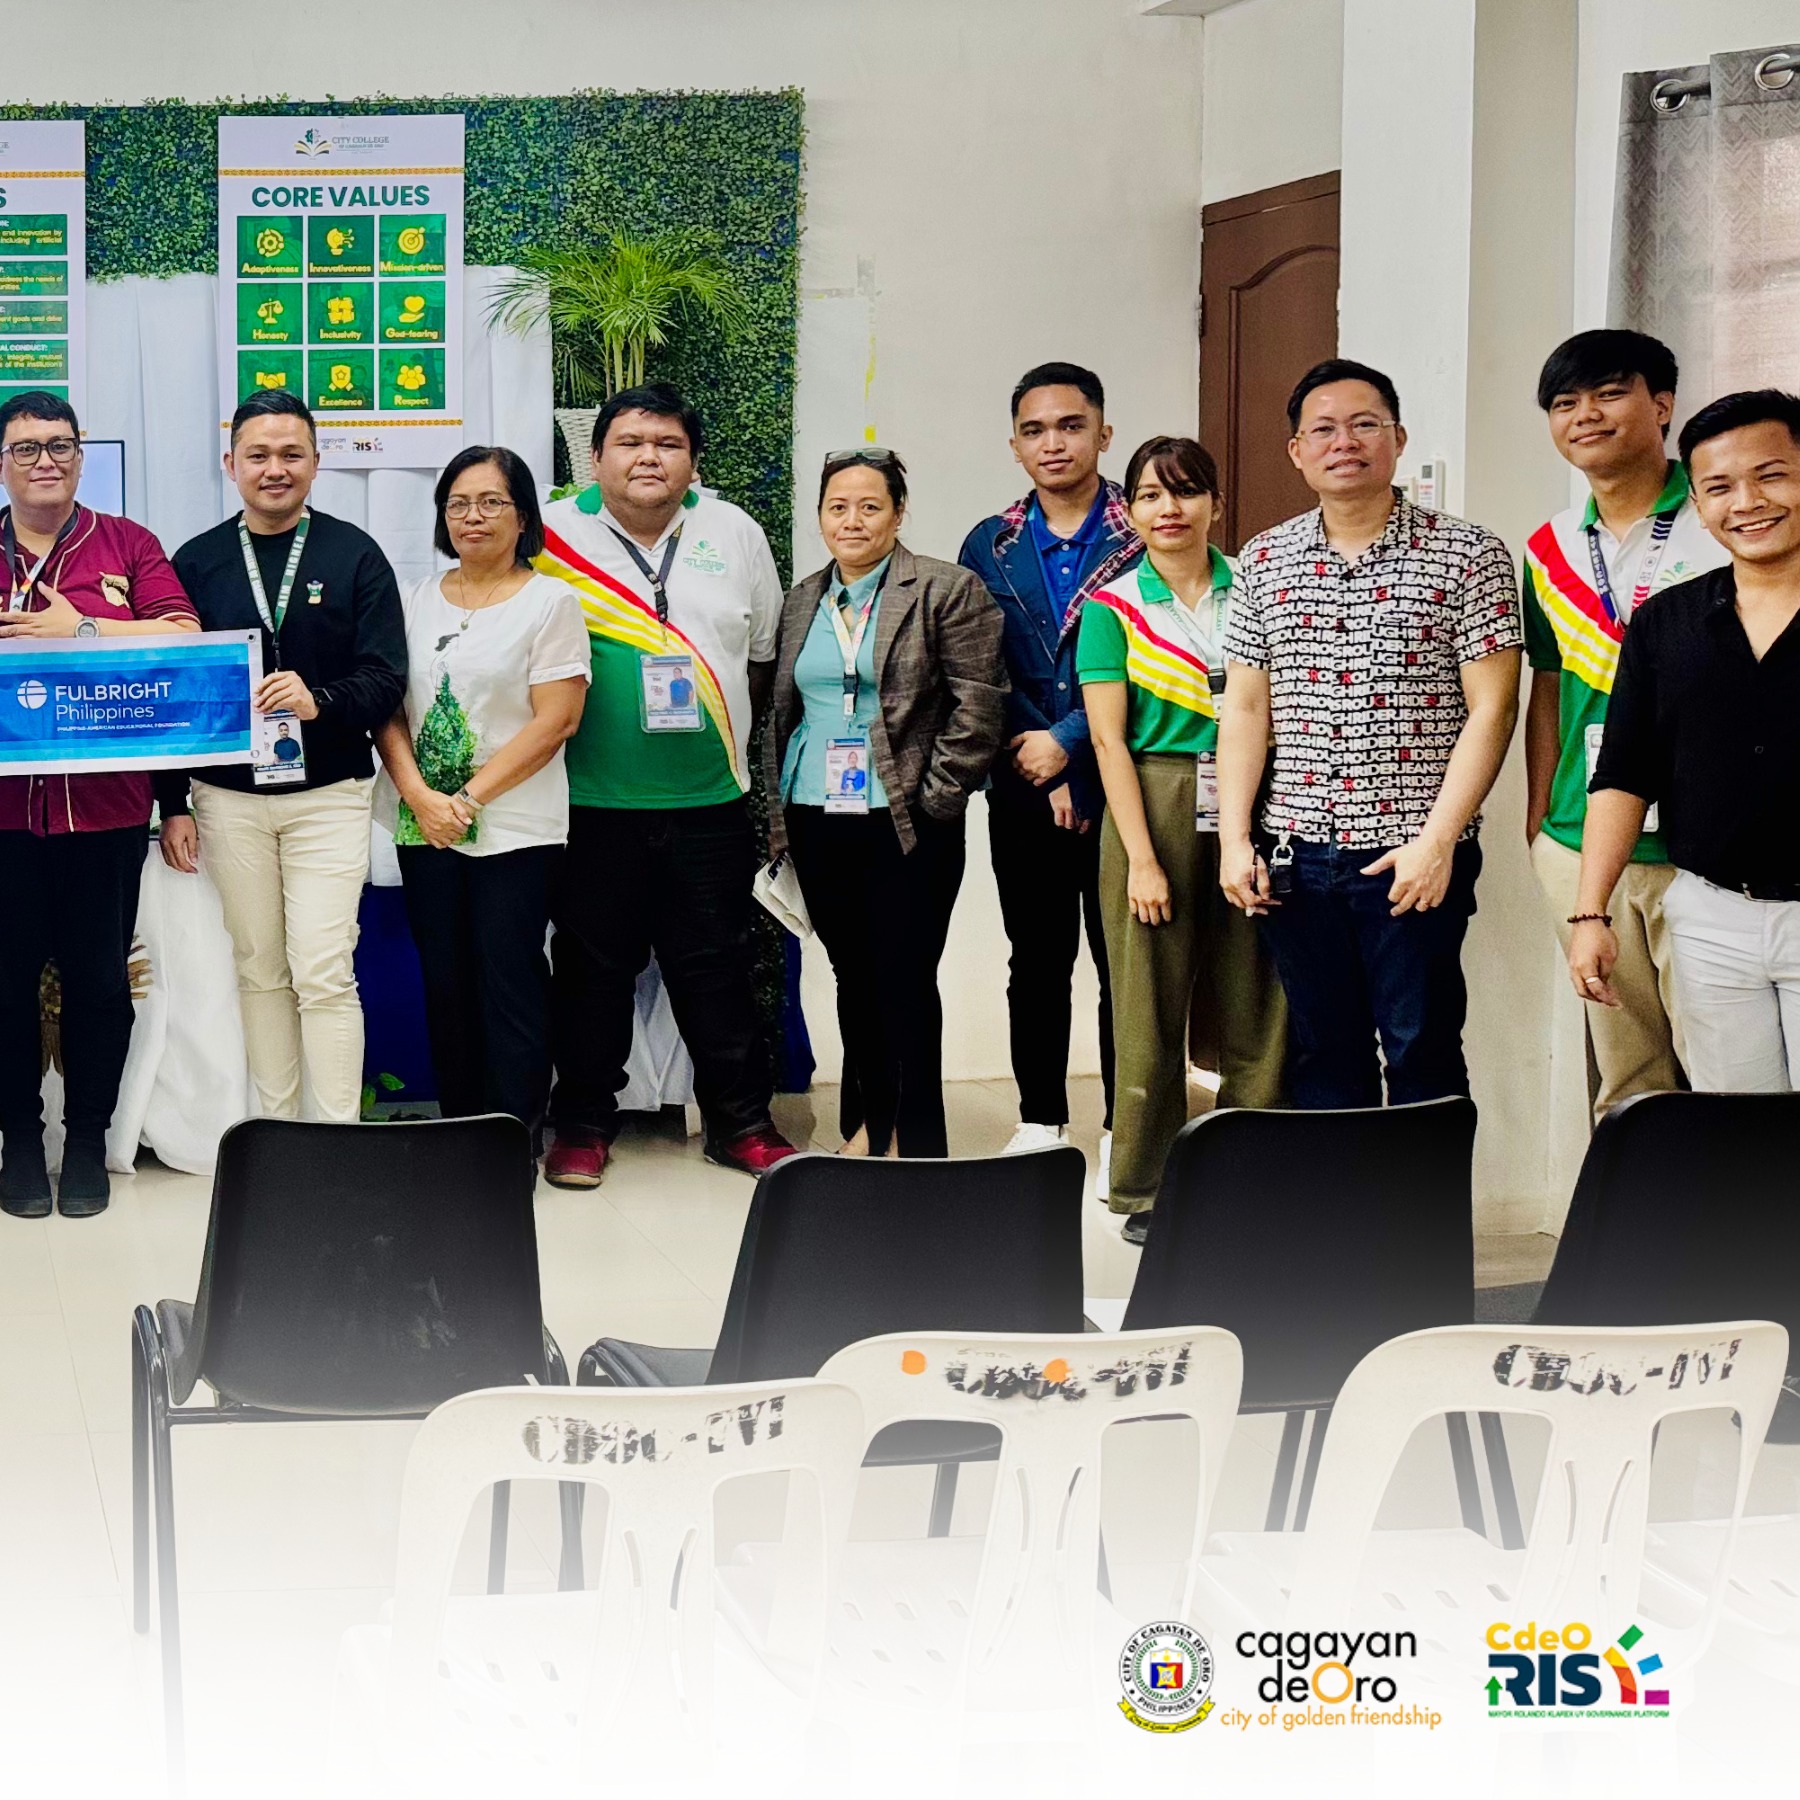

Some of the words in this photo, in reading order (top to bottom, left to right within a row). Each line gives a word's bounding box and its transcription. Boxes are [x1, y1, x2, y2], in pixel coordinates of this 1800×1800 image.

[251, 186, 323, 207] CORE
[328, 185, 430, 207] VALUES
[241, 262, 299, 275] Adaptiveness
[309, 261, 372, 273] Innovativeness
[380, 261, 445, 273] Mission-driven
[252, 329, 288, 342] Honesty
[319, 328, 362, 341] Inclusivity
[318, 396, 362, 407] Excellence
[394, 396, 429, 409] Respect
[1344, 585, 1399, 604] ROUGH
[55, 681, 172, 702] FULBRIGHT
[1342, 694, 1398, 711] ROUGH
[1399, 694, 1437, 707] RIDER
[56, 703, 155, 723] Philippines
[1342, 722, 1398, 738] ROUGH
[1344, 749, 1399, 765] ROUGH
[1344, 776, 1401, 791] ROUGH
[1346, 801, 1403, 816] ROUGH
